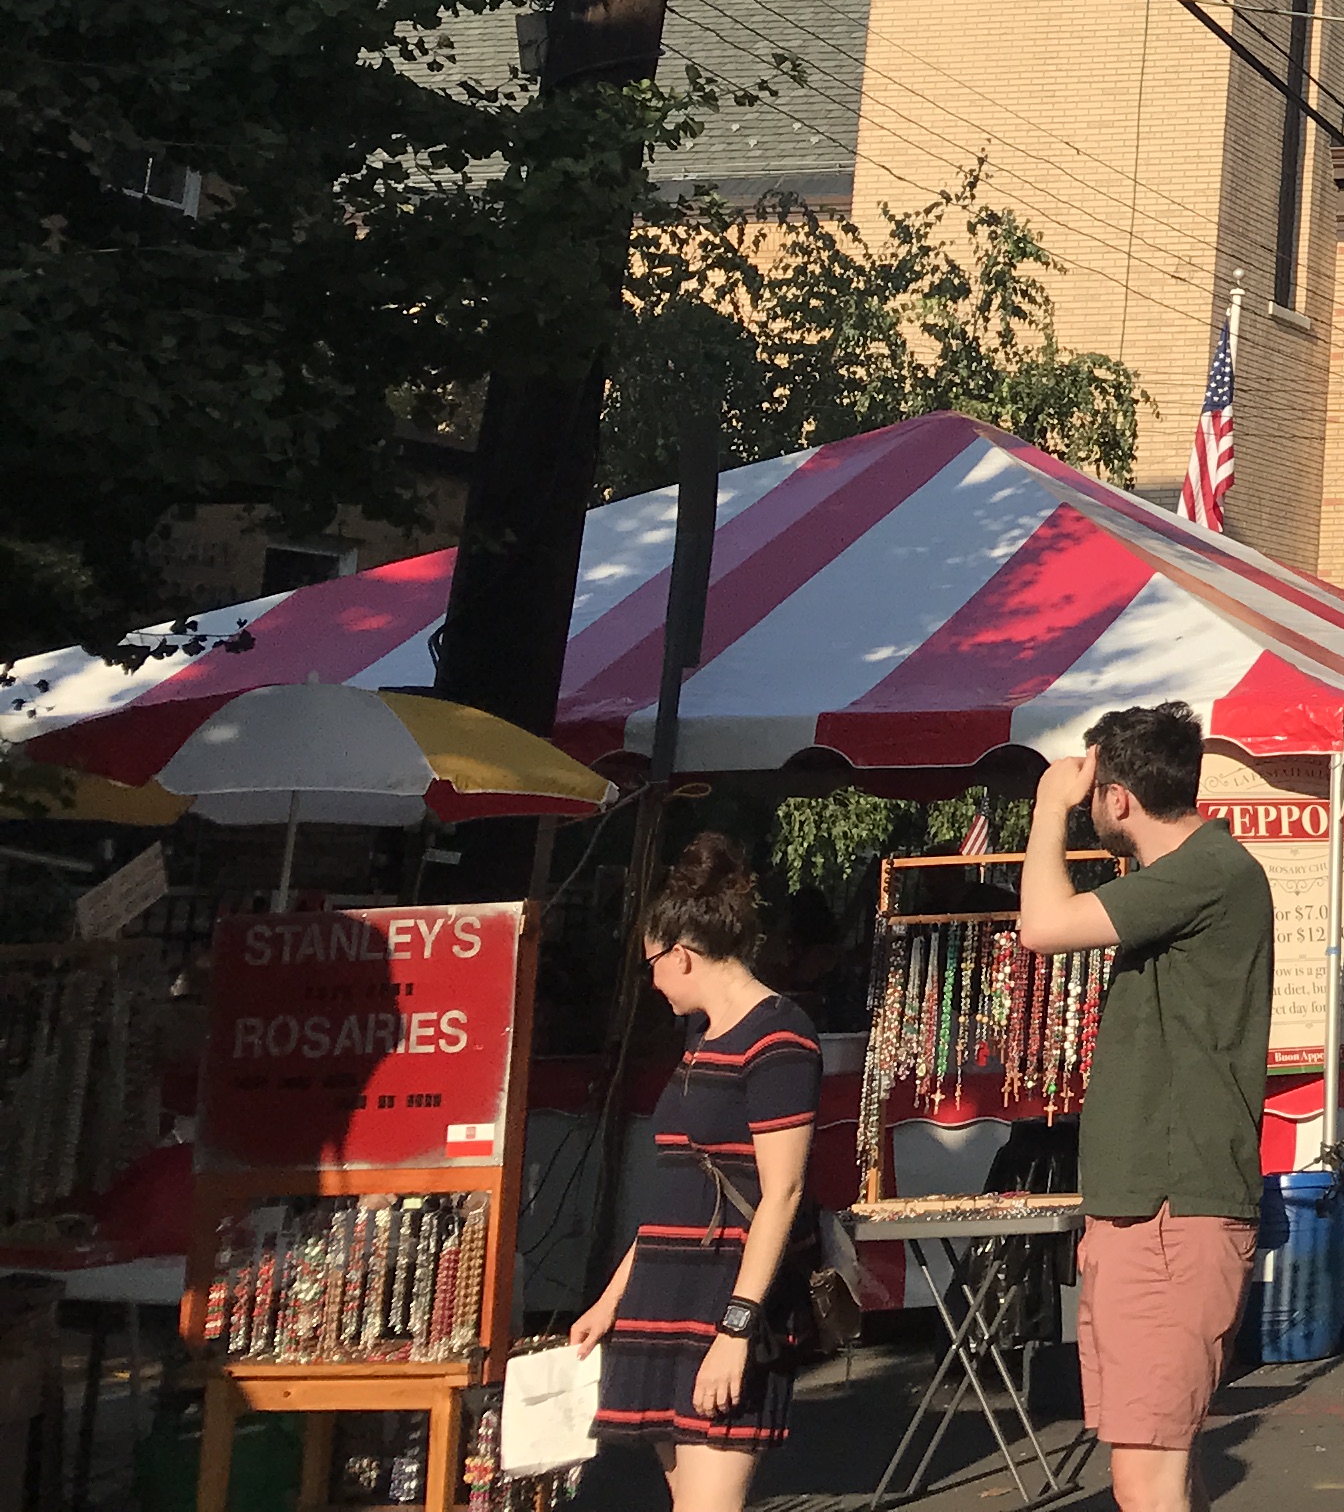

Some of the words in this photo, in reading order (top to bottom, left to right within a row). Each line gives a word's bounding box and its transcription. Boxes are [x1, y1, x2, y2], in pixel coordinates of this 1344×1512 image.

[1269, 863, 1308, 875] ROSARY
[244, 906, 483, 967] STANLEY'S
[1287, 1000, 1310, 1019] day
[232, 1009, 469, 1060] ROSARIES
[1274, 1052, 1299, 1063] Buon
